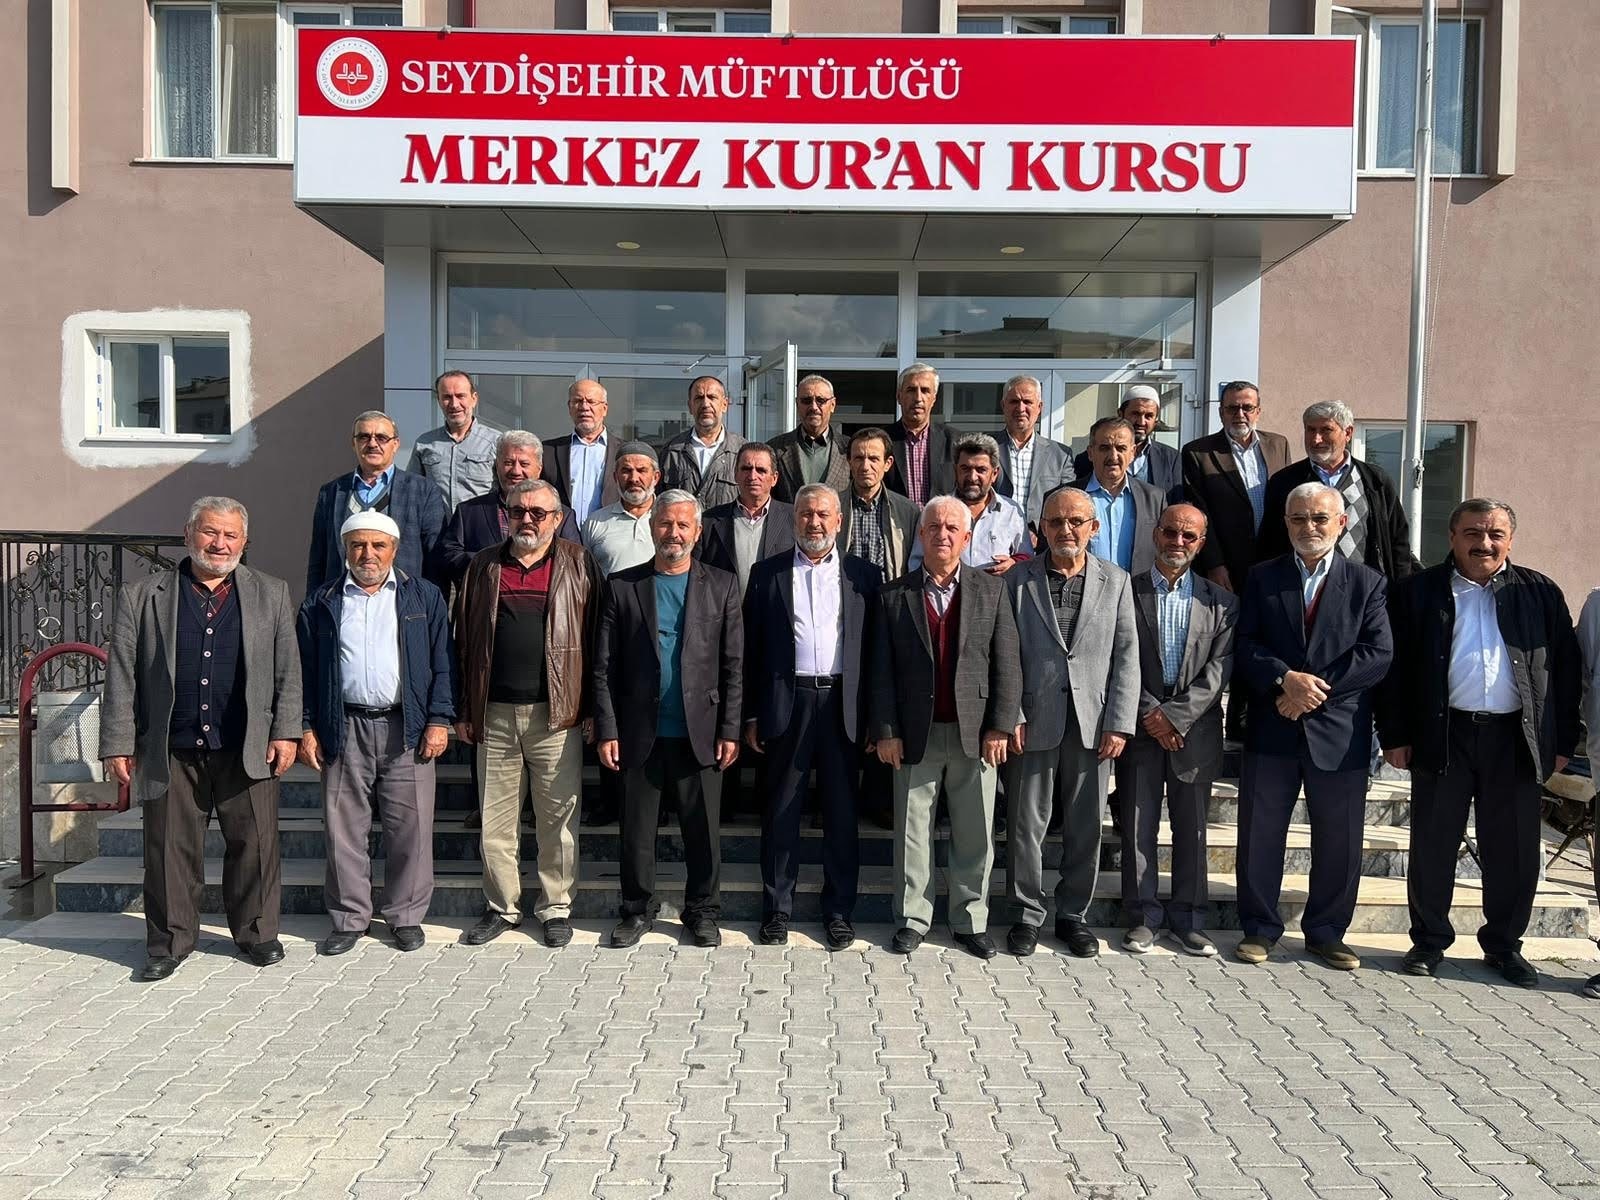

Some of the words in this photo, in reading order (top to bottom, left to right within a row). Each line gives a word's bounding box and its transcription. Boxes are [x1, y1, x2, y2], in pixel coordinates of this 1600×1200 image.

[402, 54, 669, 105] SEYDİŞEHİR
[677, 57, 963, 100] MÜFTÜLÜĞÜ
[400, 134, 701, 188] MERKEZ
[1007, 141, 1251, 193] KURSU
